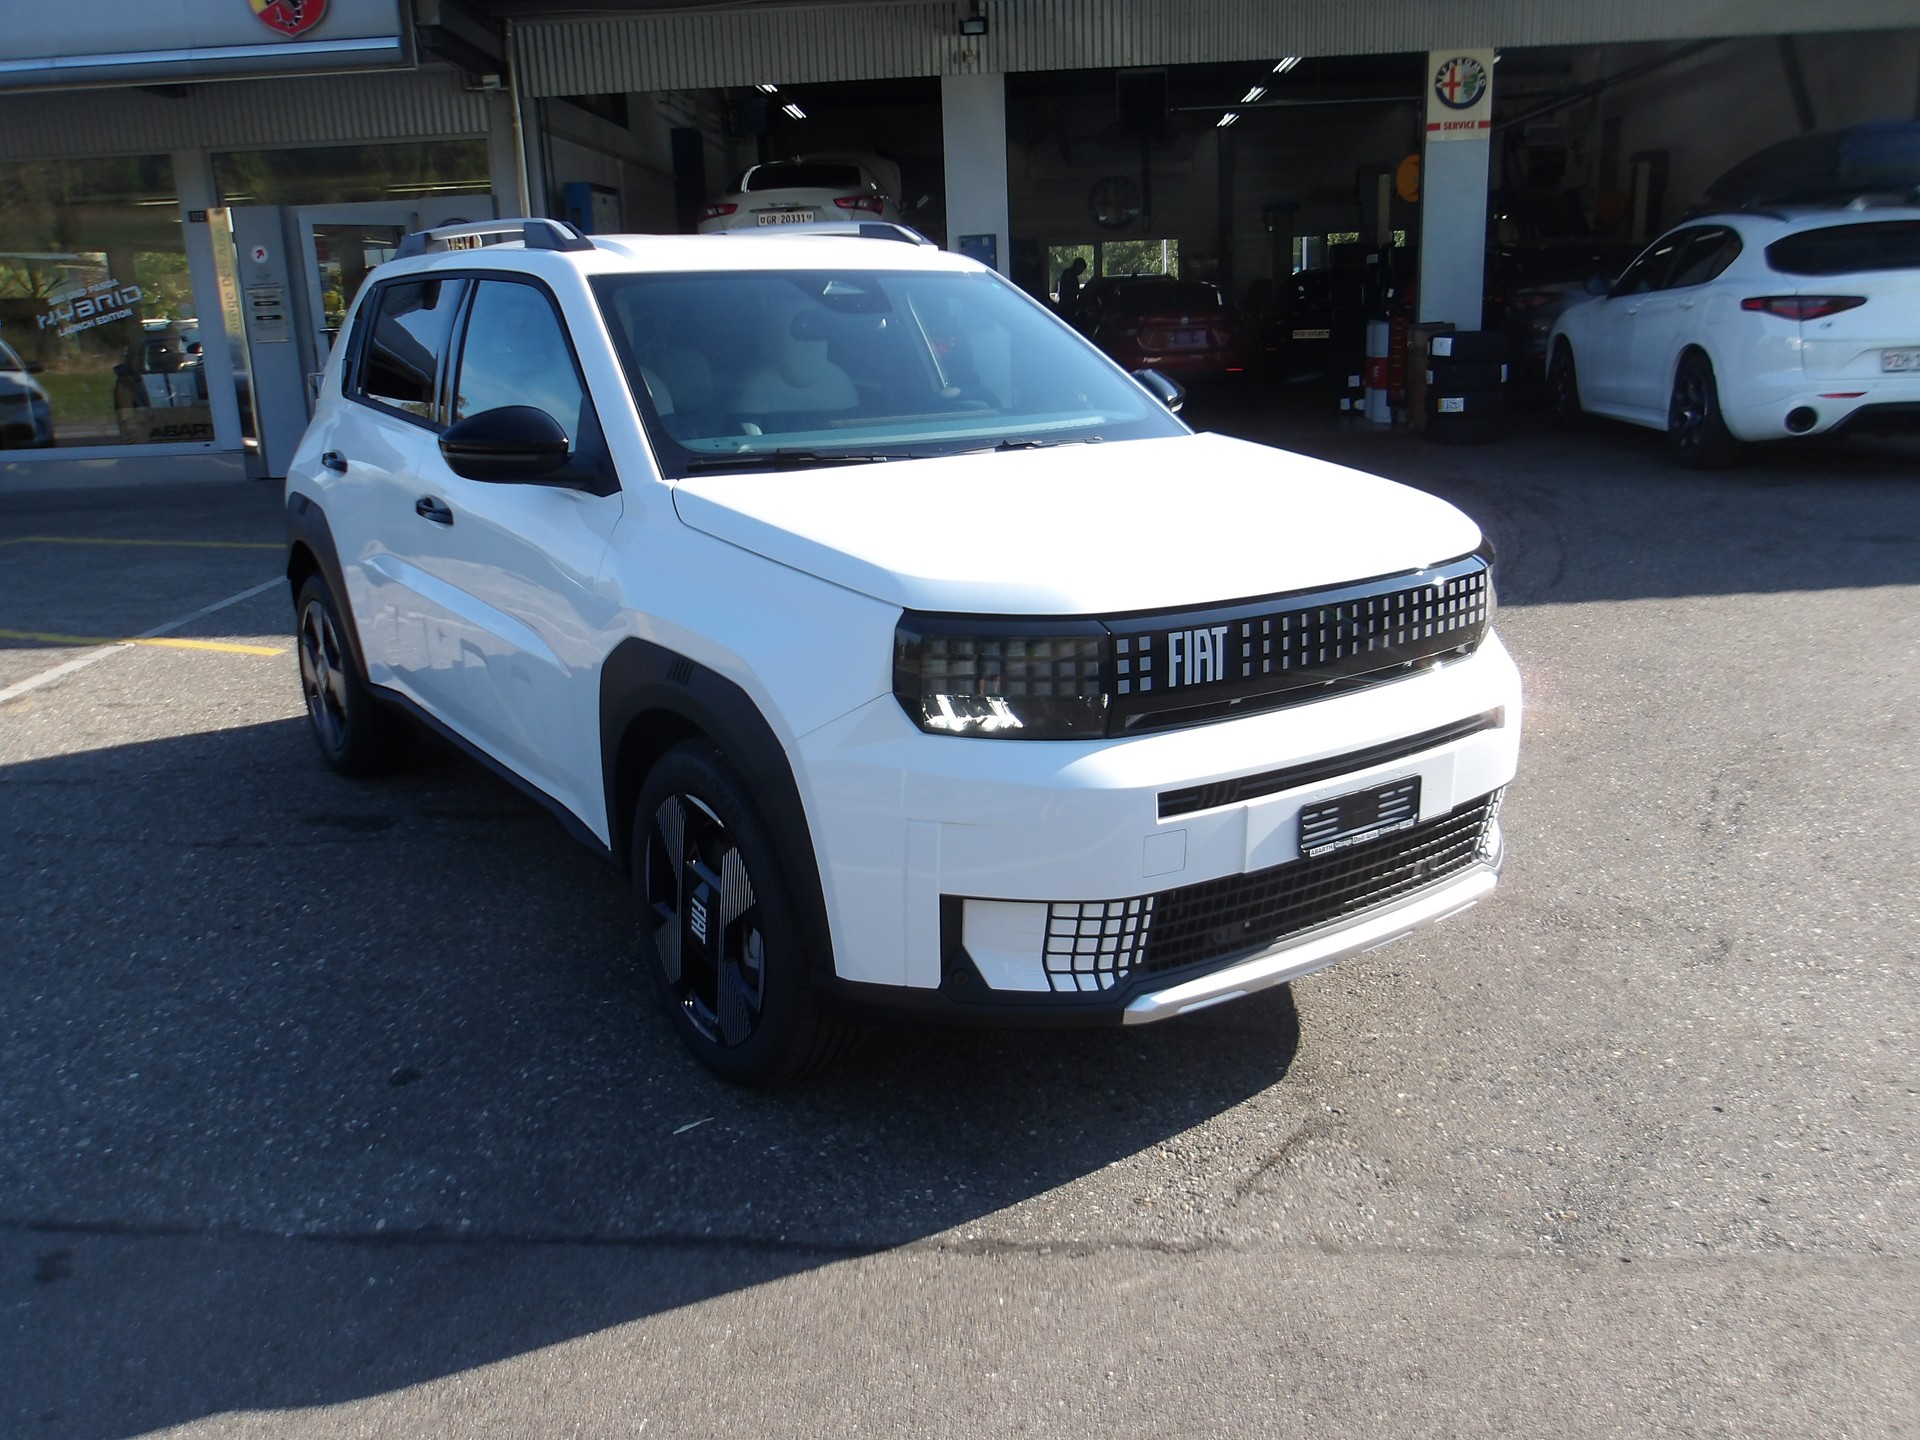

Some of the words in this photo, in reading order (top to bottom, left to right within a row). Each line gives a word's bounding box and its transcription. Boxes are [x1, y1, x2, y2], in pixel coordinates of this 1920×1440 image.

[1443, 121, 1476, 131] SERVICE
[36, 285, 142, 330] HYBRID
[57, 319, 96, 338] LAUNCH
[95, 307, 134, 326] EDITION
[1168, 626, 1228, 688] FIAT
[691, 897, 706, 945] FIAT
